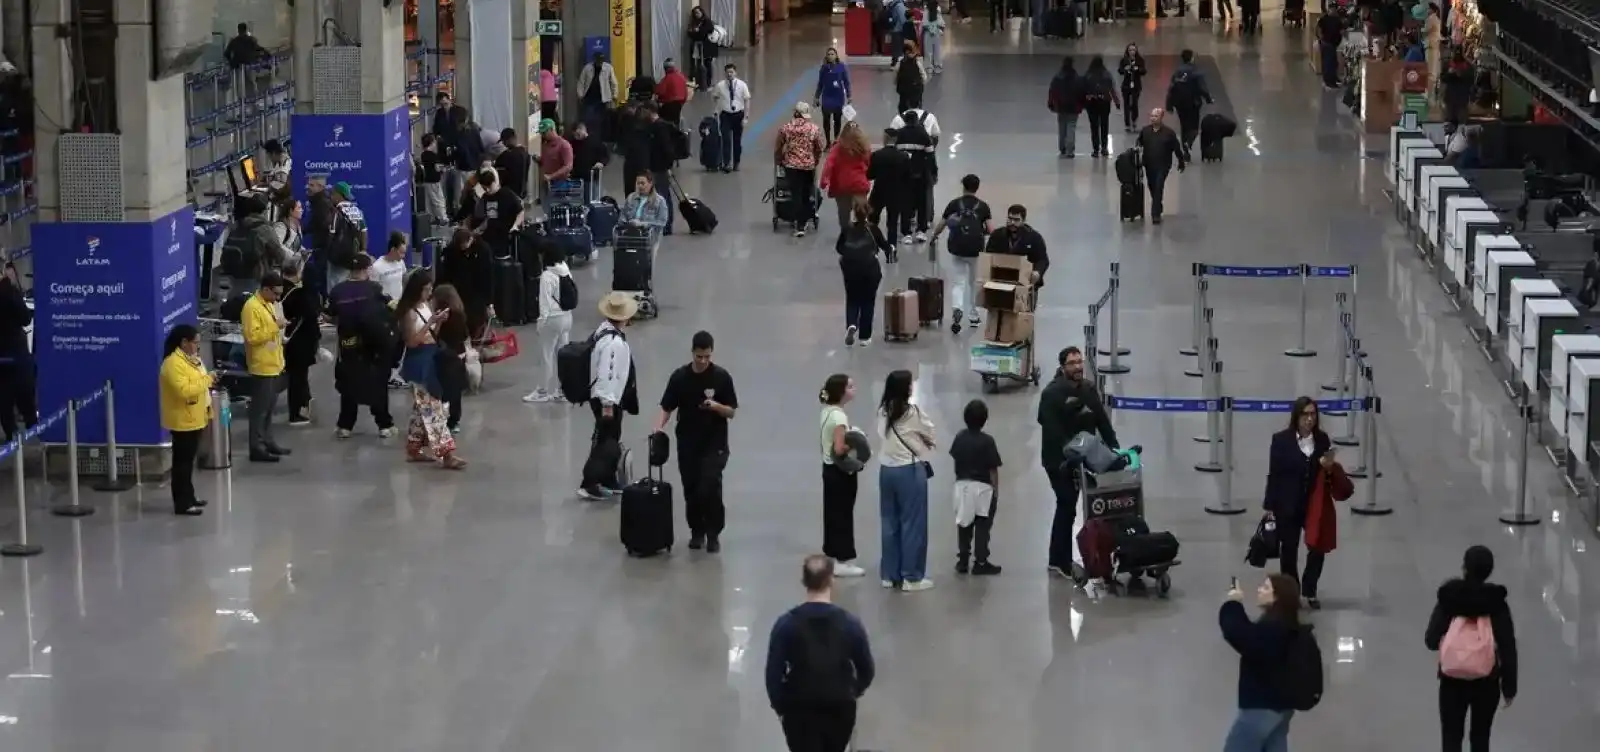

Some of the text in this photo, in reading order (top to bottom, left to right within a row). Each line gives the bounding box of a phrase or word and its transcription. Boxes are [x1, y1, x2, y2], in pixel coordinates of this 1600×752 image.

[304, 160, 362, 171] Começa aqui!
[76, 258, 110, 266] LATAM
[50, 282, 124, 296] Começa aqui!
